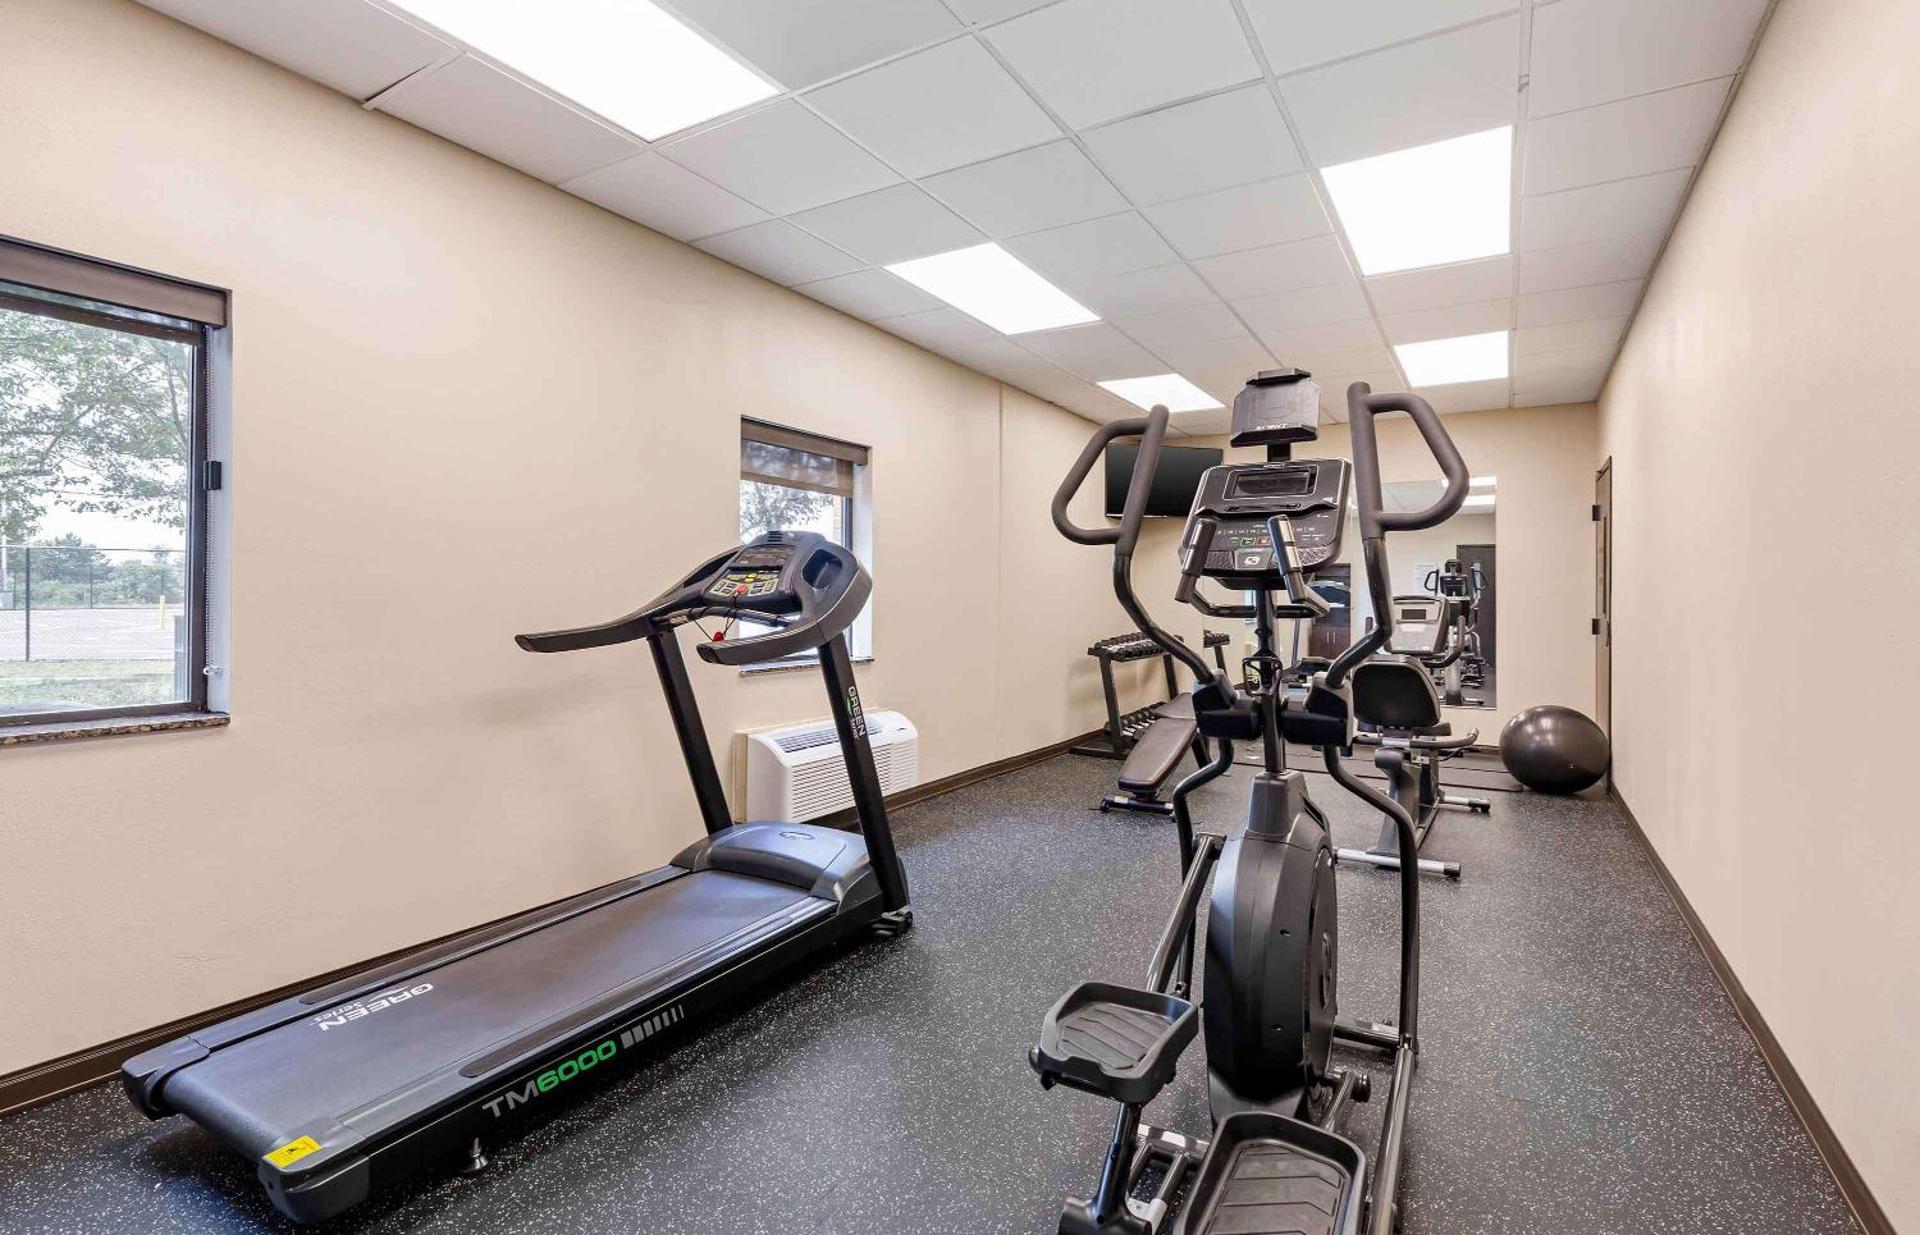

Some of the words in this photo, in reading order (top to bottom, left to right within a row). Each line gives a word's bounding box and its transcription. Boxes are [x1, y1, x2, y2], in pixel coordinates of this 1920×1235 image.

[848, 686, 866, 737] GREEN
[319, 983, 434, 1031] GREEN
[482, 1040, 617, 1118] TM6000
